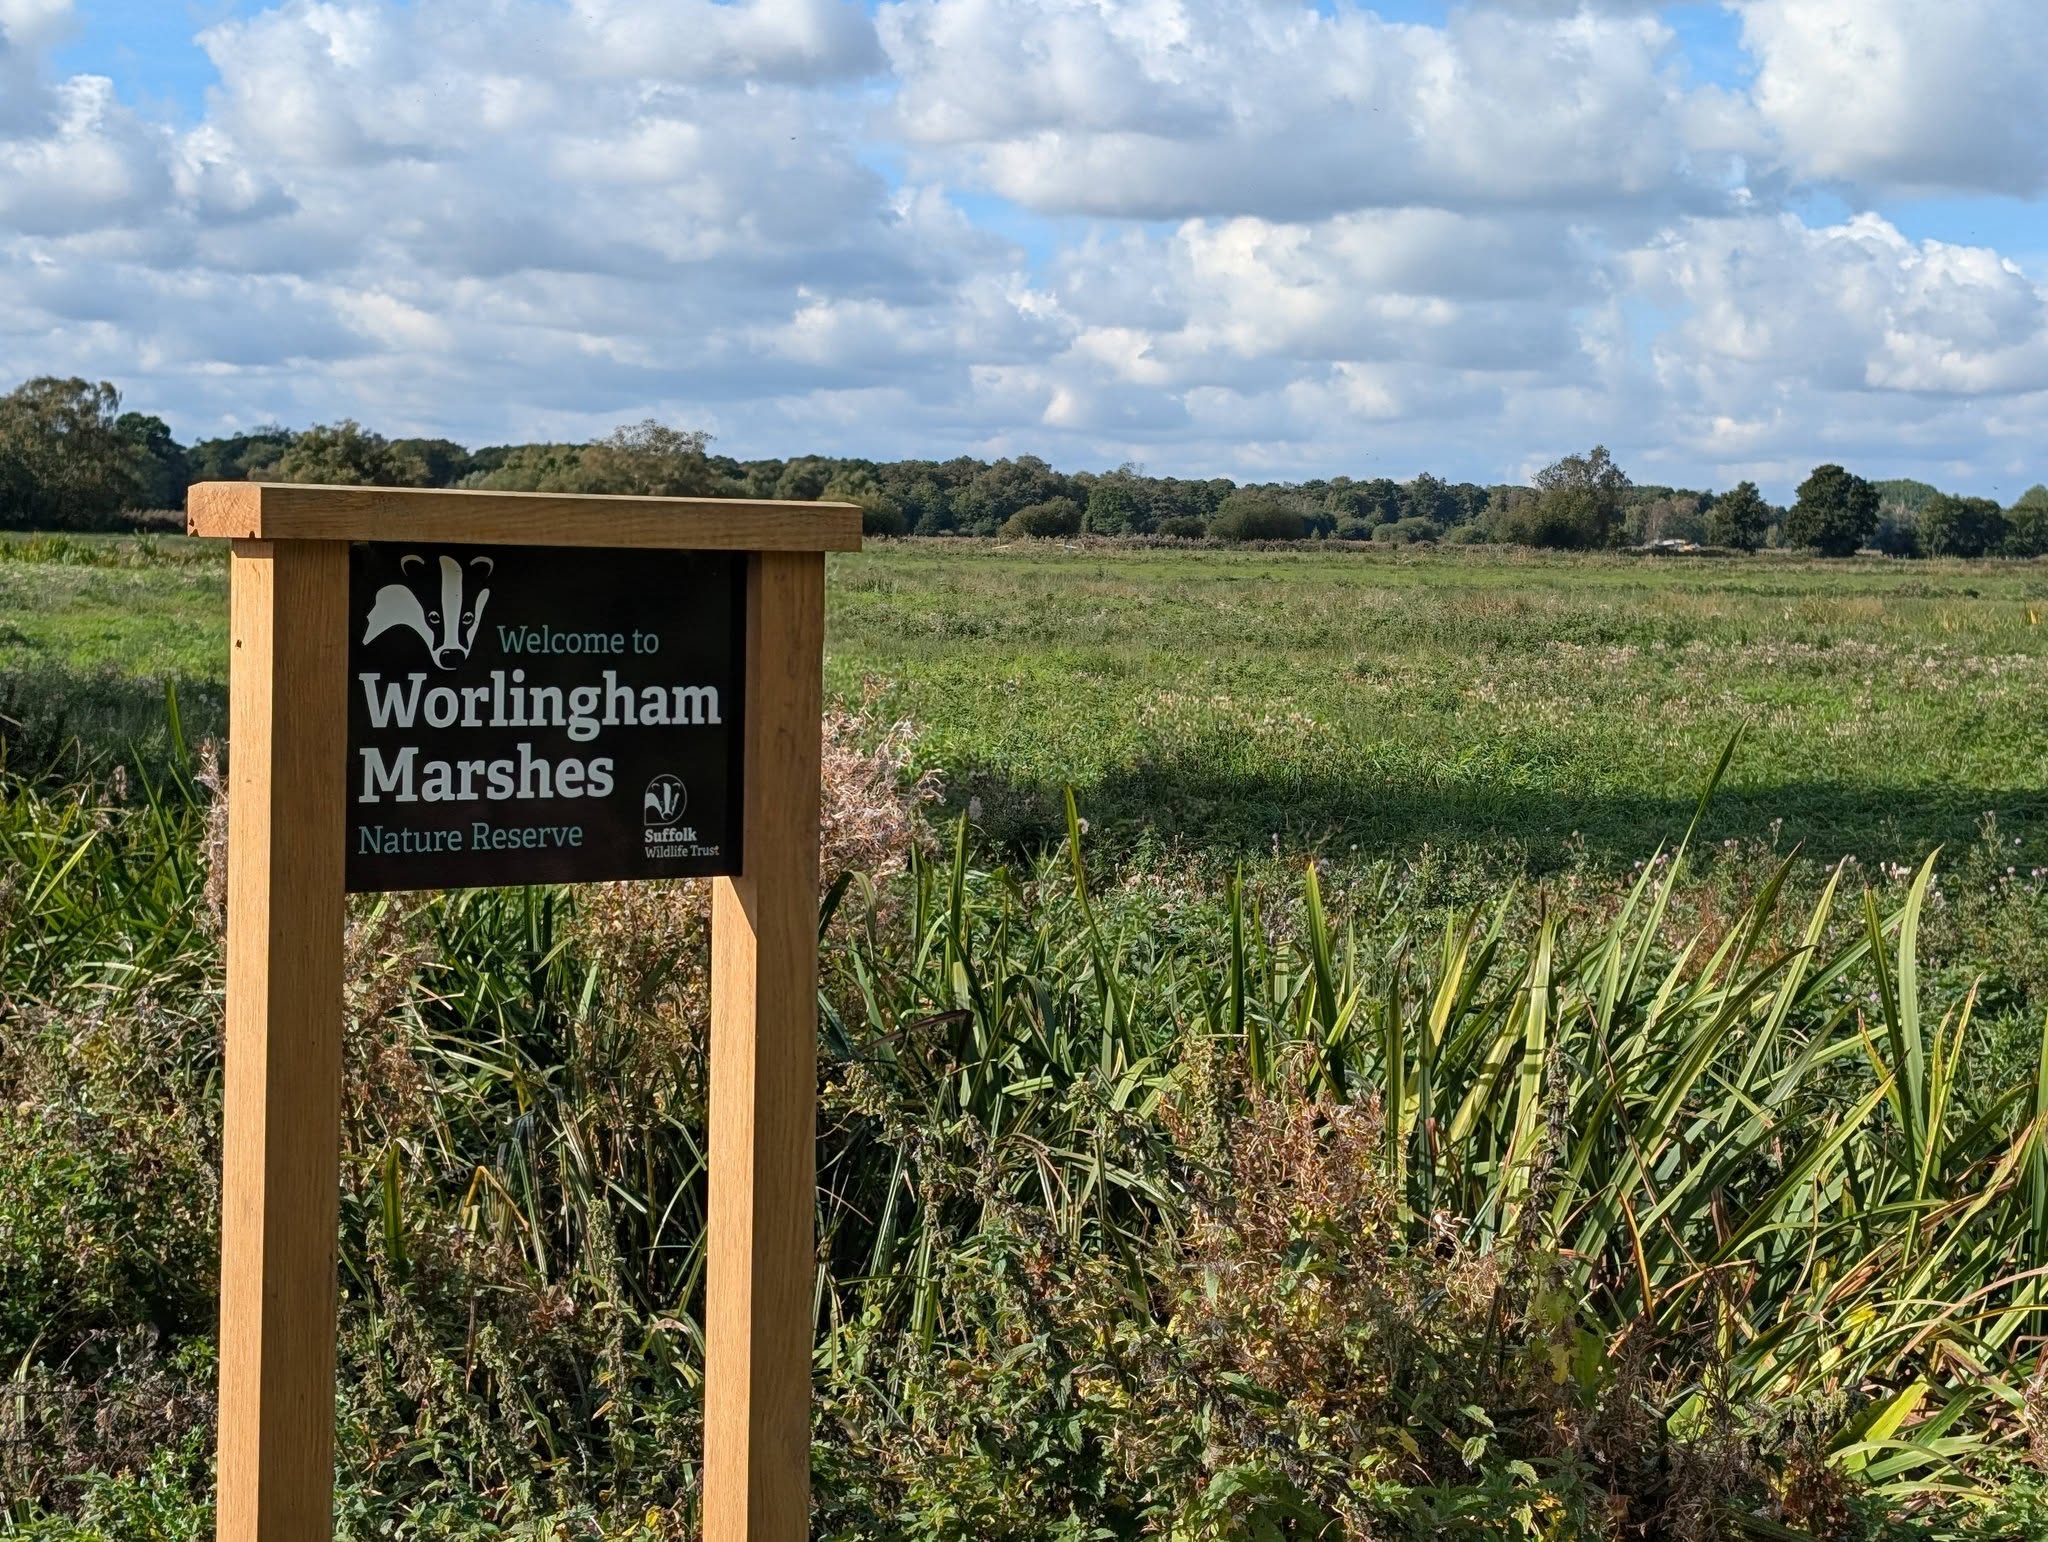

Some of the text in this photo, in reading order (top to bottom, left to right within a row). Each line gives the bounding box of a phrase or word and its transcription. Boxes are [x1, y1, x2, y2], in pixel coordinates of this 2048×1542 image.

[497, 625, 660, 654] Welcome to
[358, 669, 722, 742] Worlingham
[358, 743, 615, 803] Marshes
[358, 822, 583, 854] Nature Reserve
[644, 827, 697, 843] Suffolk
[645, 845, 720, 858] Wildlife Trust
